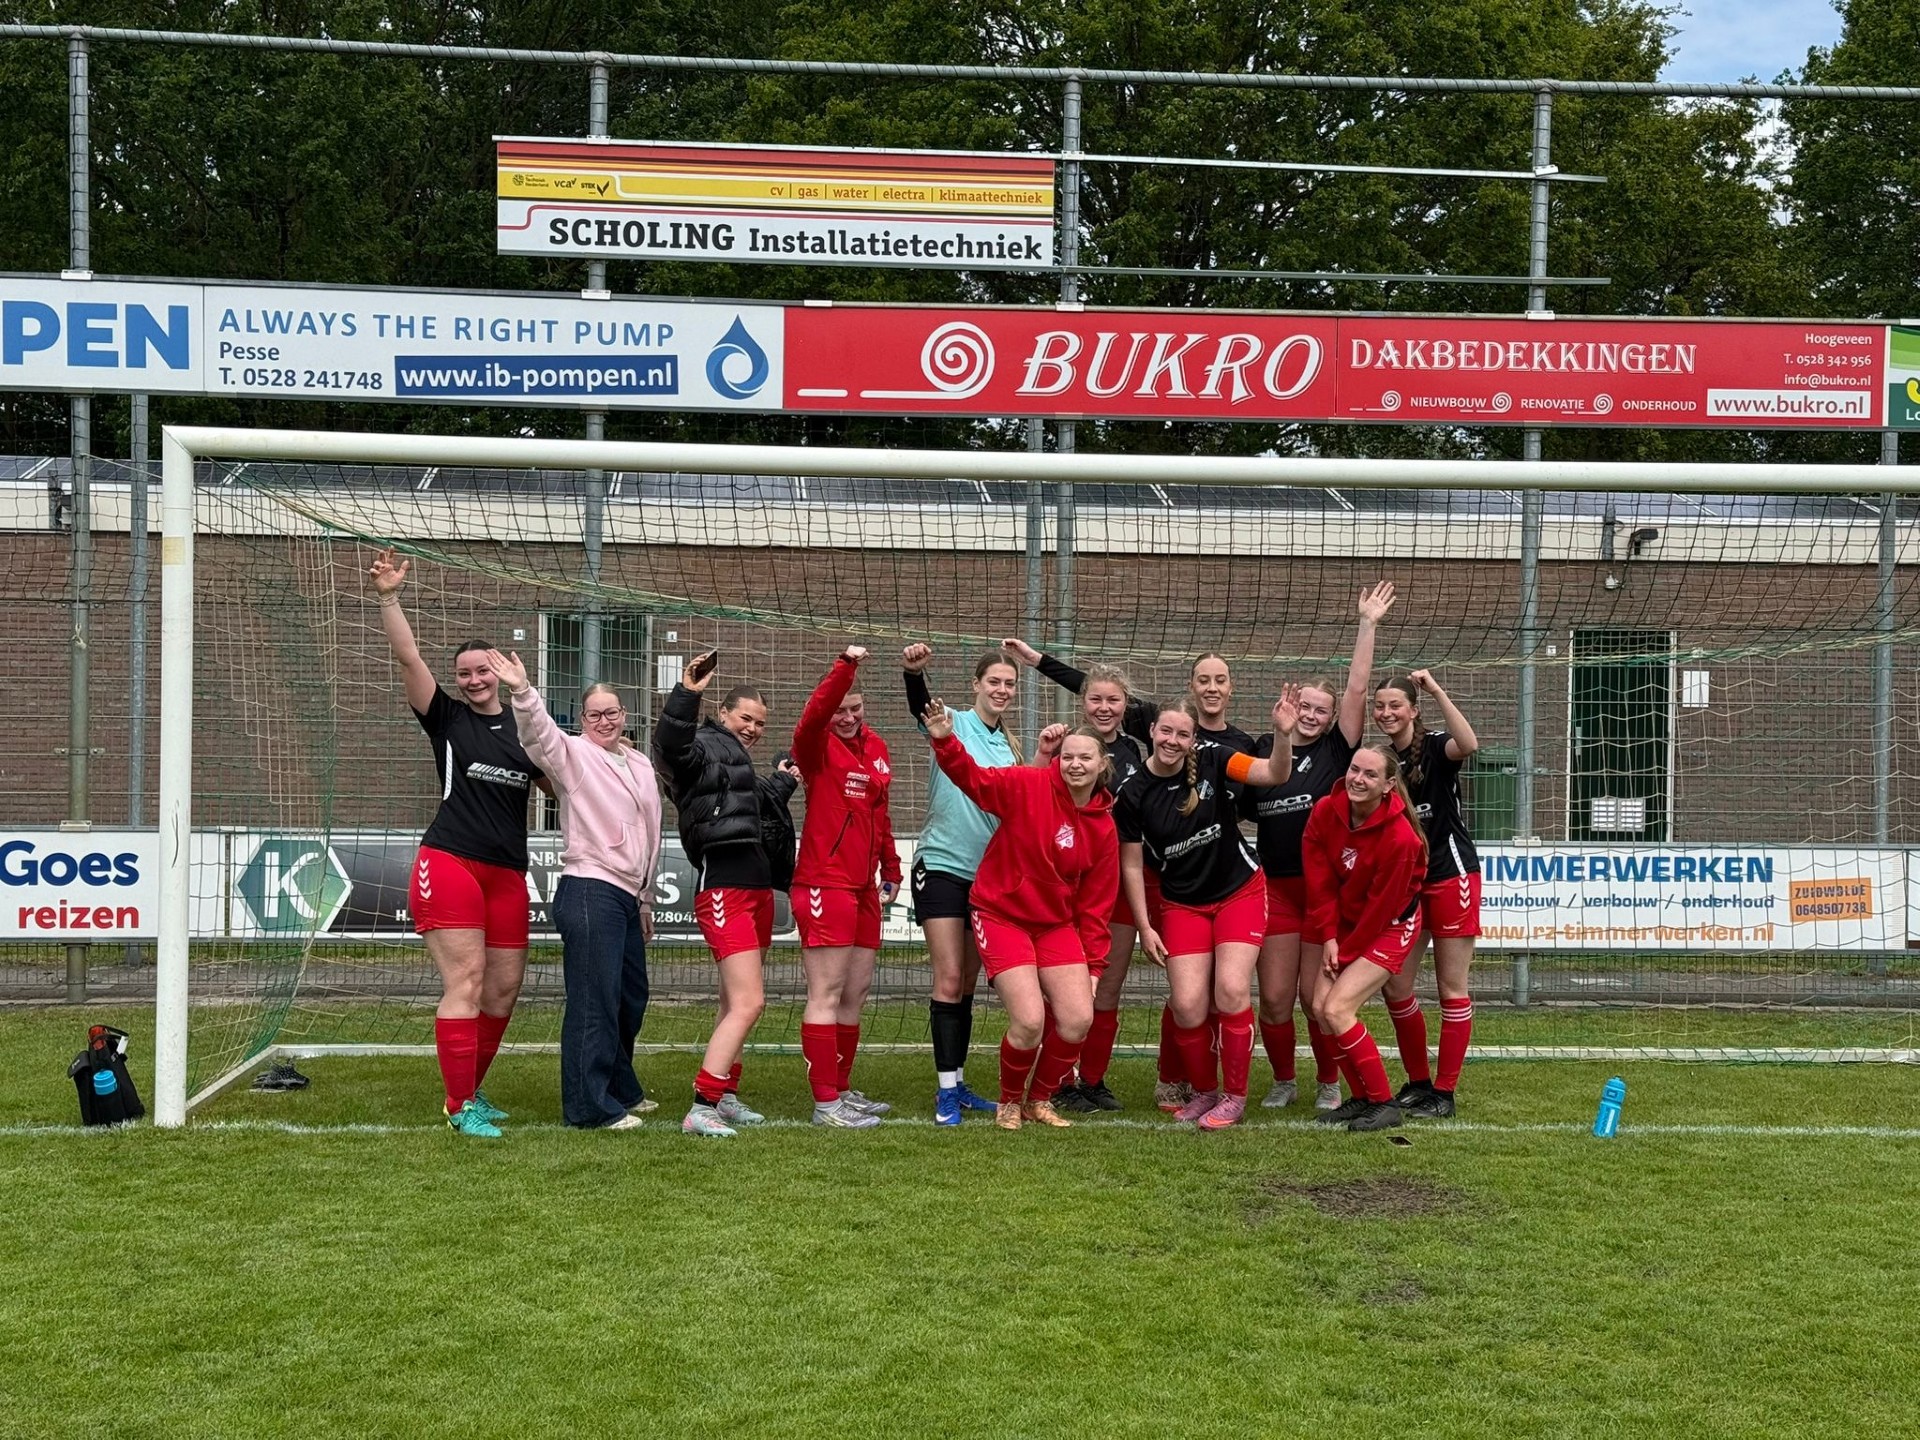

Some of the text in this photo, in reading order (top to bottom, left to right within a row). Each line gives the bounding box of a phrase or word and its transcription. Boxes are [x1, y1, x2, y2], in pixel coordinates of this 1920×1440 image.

[770, 187, 1042, 205] cv gas water electra klimaattechniek
[549, 218, 1042, 261] SCHOLING Installatietechniek
[219, 308, 674, 347] ALWAYS THE RIGHT PUMP
[1805, 333, 1872, 347] Hoogeveen
[220, 342, 280, 361] Pesse
[1350, 339, 1697, 374] DAKBEDEKKINGEN
[1784, 353, 1872, 367] T. 0528 342 956
[1014, 330, 1325, 405] BUKRO
[219, 367, 383, 390] T. 0528 241748
[400, 362, 672, 393] www.ib-pompen.nl
[1784, 373, 1871, 388] info@bukro.nl
[1410, 396, 1697, 411] NIEUWBOUW RENOVATIE ONDERHOUD
[1714, 395, 1864, 414] www.bukro.nl
[0, 840, 140, 887] Goes
[1584, 894, 1658, 908] verbouw
[1682, 894, 1774, 908] onderhoud
[18, 900, 139, 929] reizen
[1476, 922, 1774, 941] ww.rz-timmerwerken.nl
